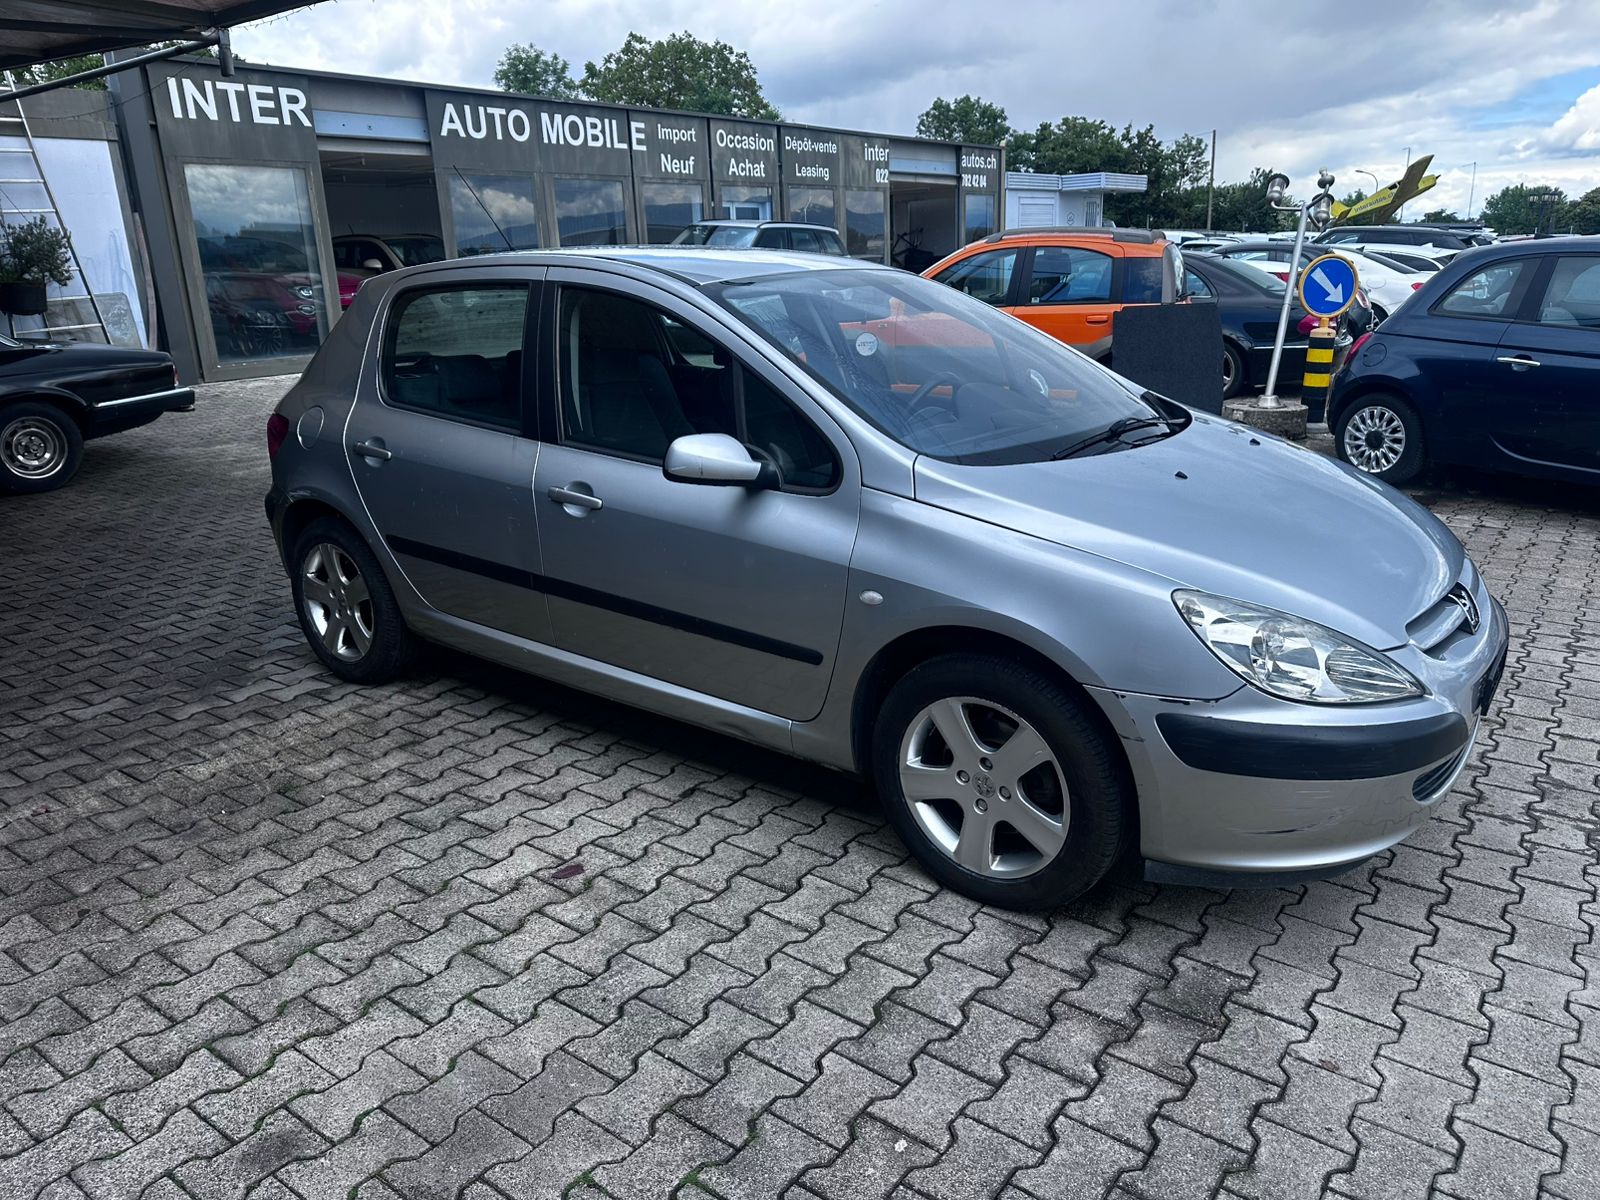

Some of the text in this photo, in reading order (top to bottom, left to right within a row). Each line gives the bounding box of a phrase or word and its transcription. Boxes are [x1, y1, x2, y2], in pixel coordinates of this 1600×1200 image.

[166, 76, 647, 151] INTER AUTO MOBILE
[657, 123, 697, 144] Import
[716, 128, 775, 152] Occasion
[784, 135, 837, 154] Dépôt-vente
[660, 153, 695, 175] Neuf
[864, 143, 997, 169] inter autos.ch
[728, 157, 766, 178] Achat
[795, 162, 830, 181] Leasing
[875, 168, 889, 184] 022
